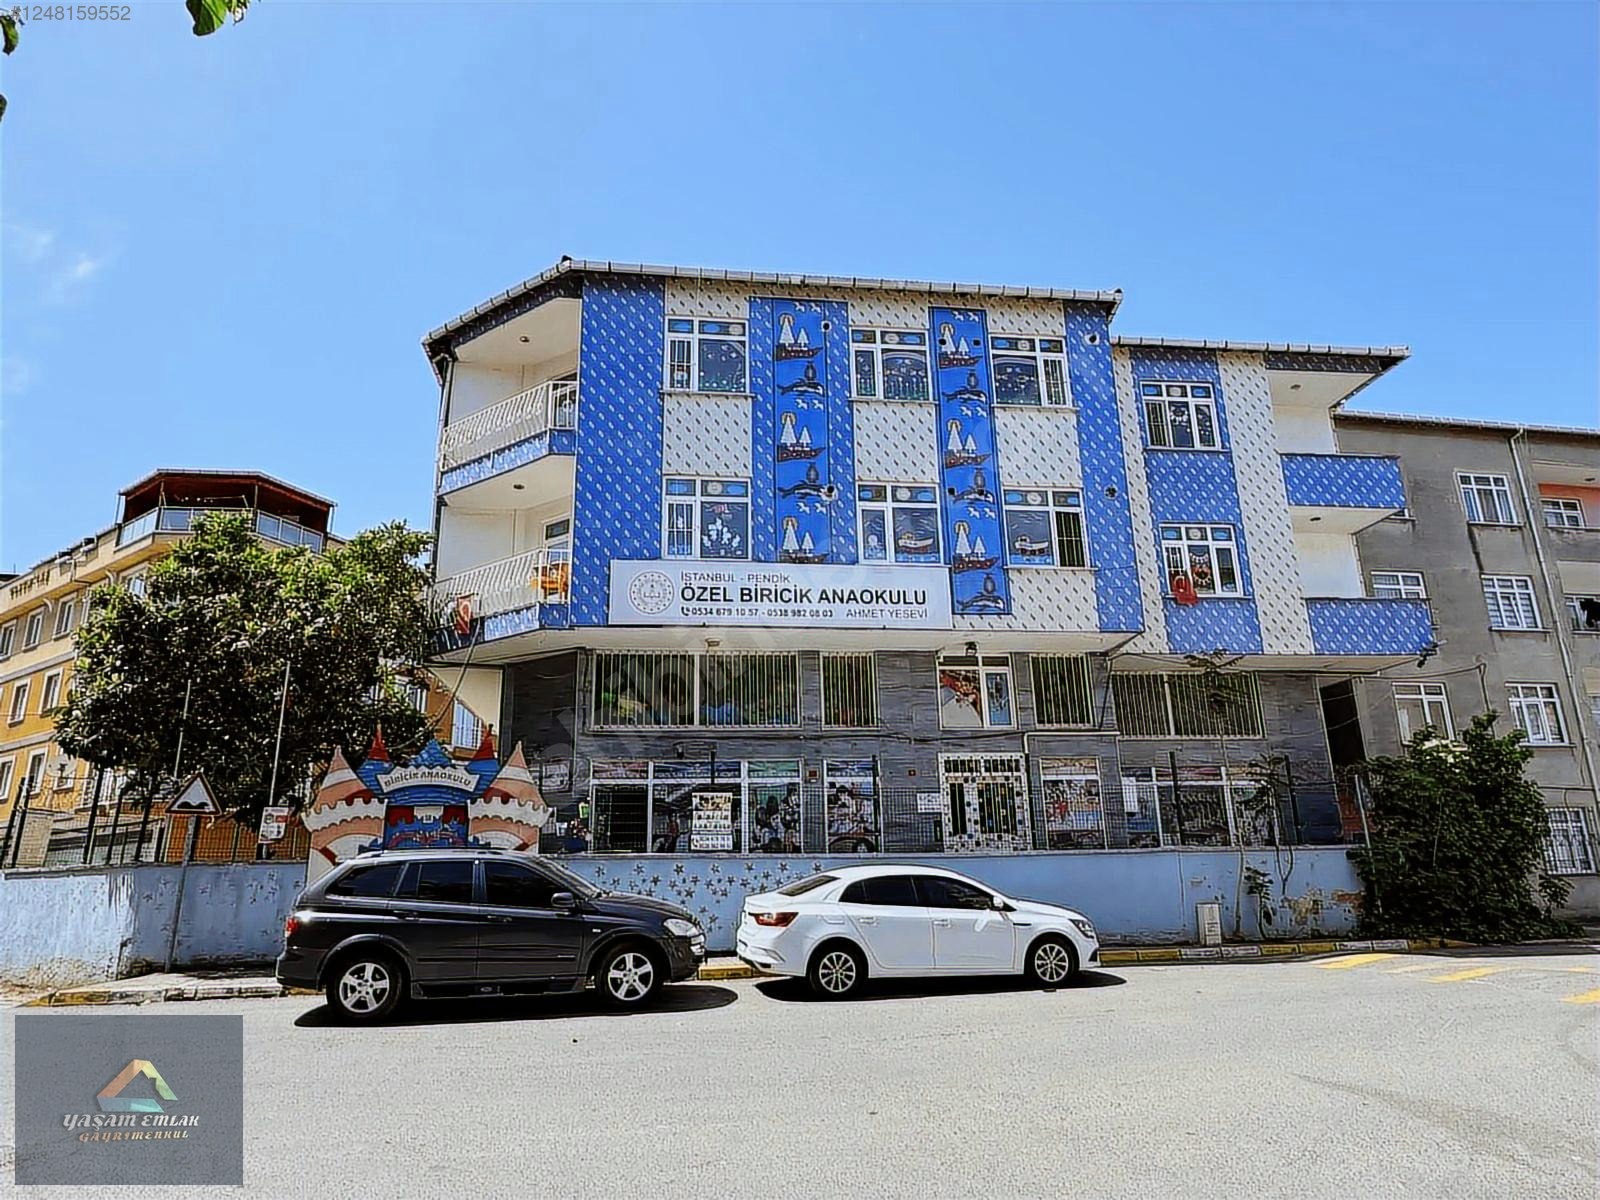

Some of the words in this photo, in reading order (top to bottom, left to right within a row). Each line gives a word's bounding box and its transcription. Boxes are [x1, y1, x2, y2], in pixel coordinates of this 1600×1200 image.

[681, 571, 735, 582] İSTANBUL
[747, 573, 791, 583] PENDİK
[681, 582, 734, 602] ÖZEL
[740, 583, 812, 603] BİRİCİK
[818, 588, 926, 605] ANAOKULU
[691, 607, 713, 616] 0534
[736, 608, 746, 616] 10
[846, 609, 884, 618] AHMET
[888, 608, 928, 619] YESEVİ
